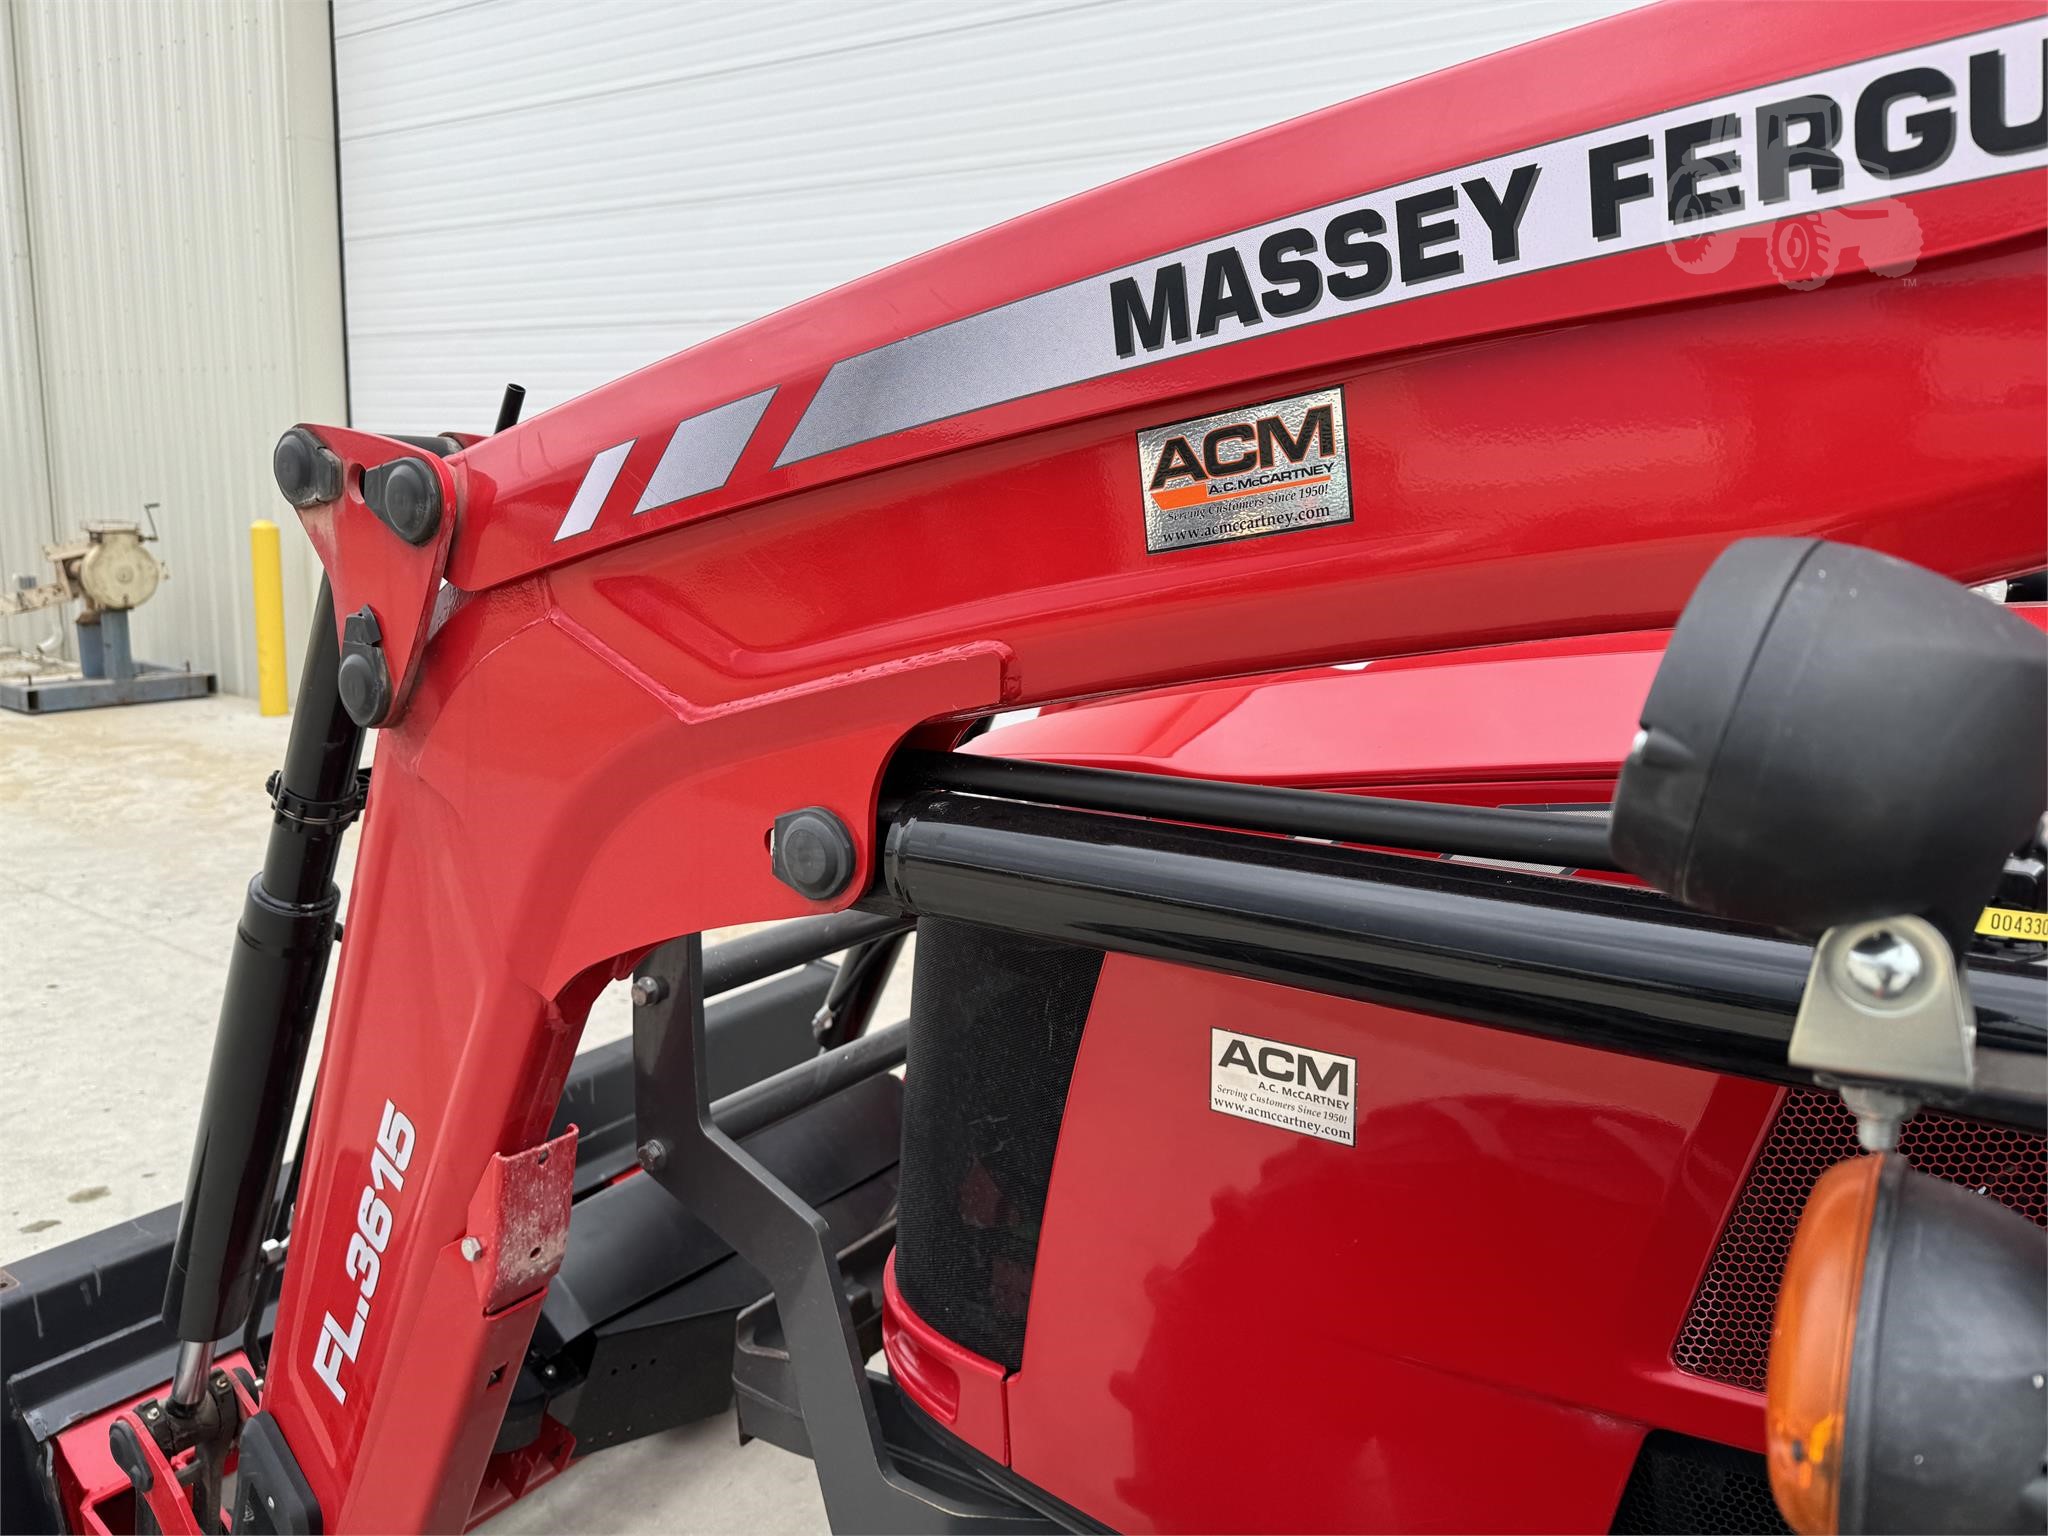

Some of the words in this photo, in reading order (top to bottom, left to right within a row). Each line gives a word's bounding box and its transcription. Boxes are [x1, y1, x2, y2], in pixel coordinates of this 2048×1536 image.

[1109, 164, 1542, 358] MASSEY
[1150, 403, 1336, 491] ACM
[1167, 507, 1206, 522] Serving
[1208, 498, 1265, 516] Customers
[1267, 492, 1297, 505] Since
[1299, 483, 1329, 499] 1950!
[1162, 506, 1331, 543] www.acmccartney.com
[1218, 1039, 1349, 1097] ACM
[1217, 1084, 1248, 1102] Serving
[1249, 1092, 1295, 1112] Customers
[1297, 1104, 1322, 1118] Since
[1323, 1110, 1348, 1125] 1950!
[1258, 1081, 1279, 1094] A.C.
[1282, 1086, 1350, 1111] McCARTNEY
[1214, 1097, 1351, 1140] www.acmccartney.com
[312, 1098, 416, 1406] FL.3615
